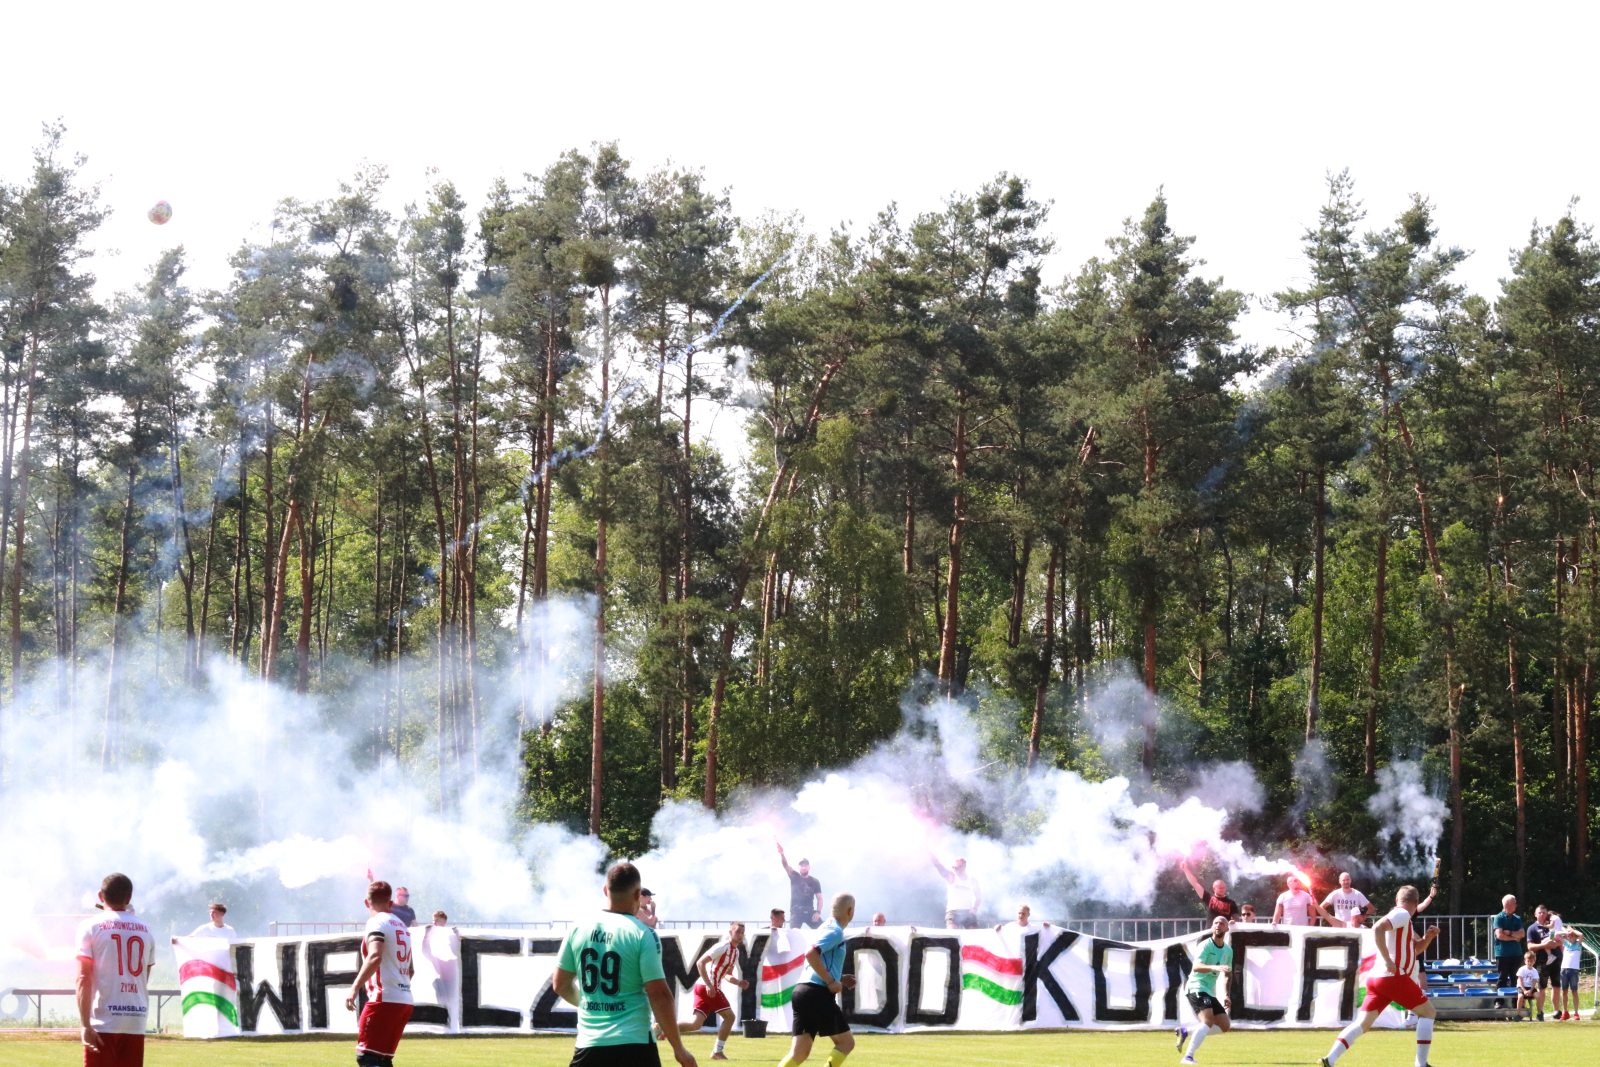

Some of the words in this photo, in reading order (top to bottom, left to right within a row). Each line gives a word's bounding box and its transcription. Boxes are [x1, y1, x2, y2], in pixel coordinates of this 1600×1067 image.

[111, 934, 144, 976] 10
[590, 929, 614, 944] IKAR
[235, 934, 770, 1030] WACZMY
[842, 936, 962, 1027] DO
[580, 947, 621, 996] 69
